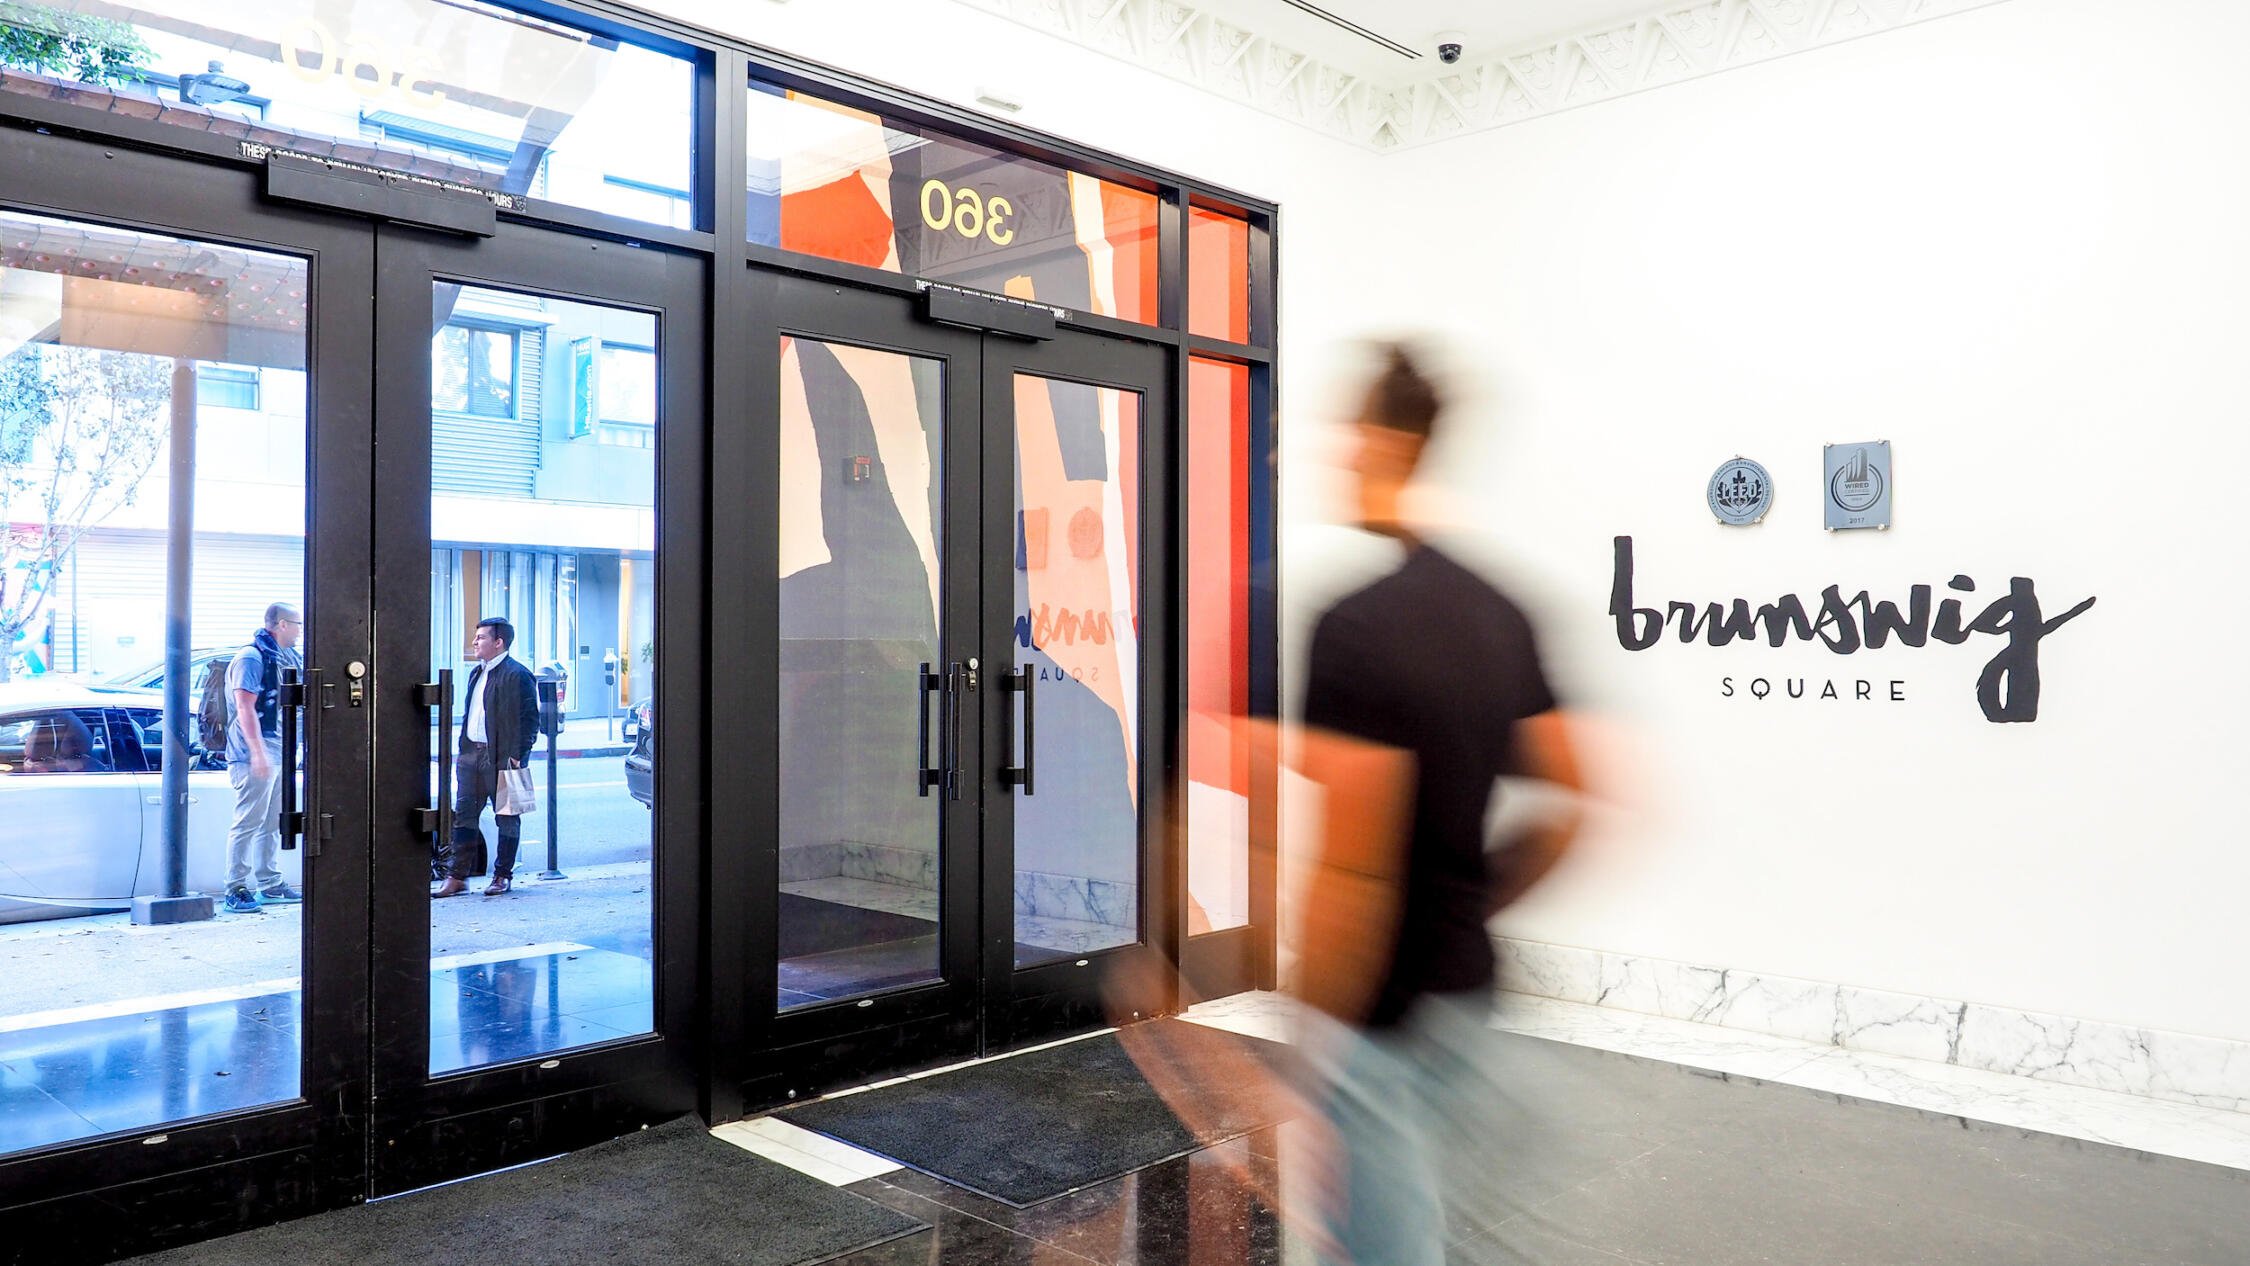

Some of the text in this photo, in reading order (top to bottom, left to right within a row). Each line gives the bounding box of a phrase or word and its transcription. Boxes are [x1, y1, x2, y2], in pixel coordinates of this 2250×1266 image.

[241, 141, 272, 160] THES
[1721, 482, 1758, 498] LEED
[1609, 536, 2096, 723] brunswig
[1722, 678, 1904, 700] SQUARE
